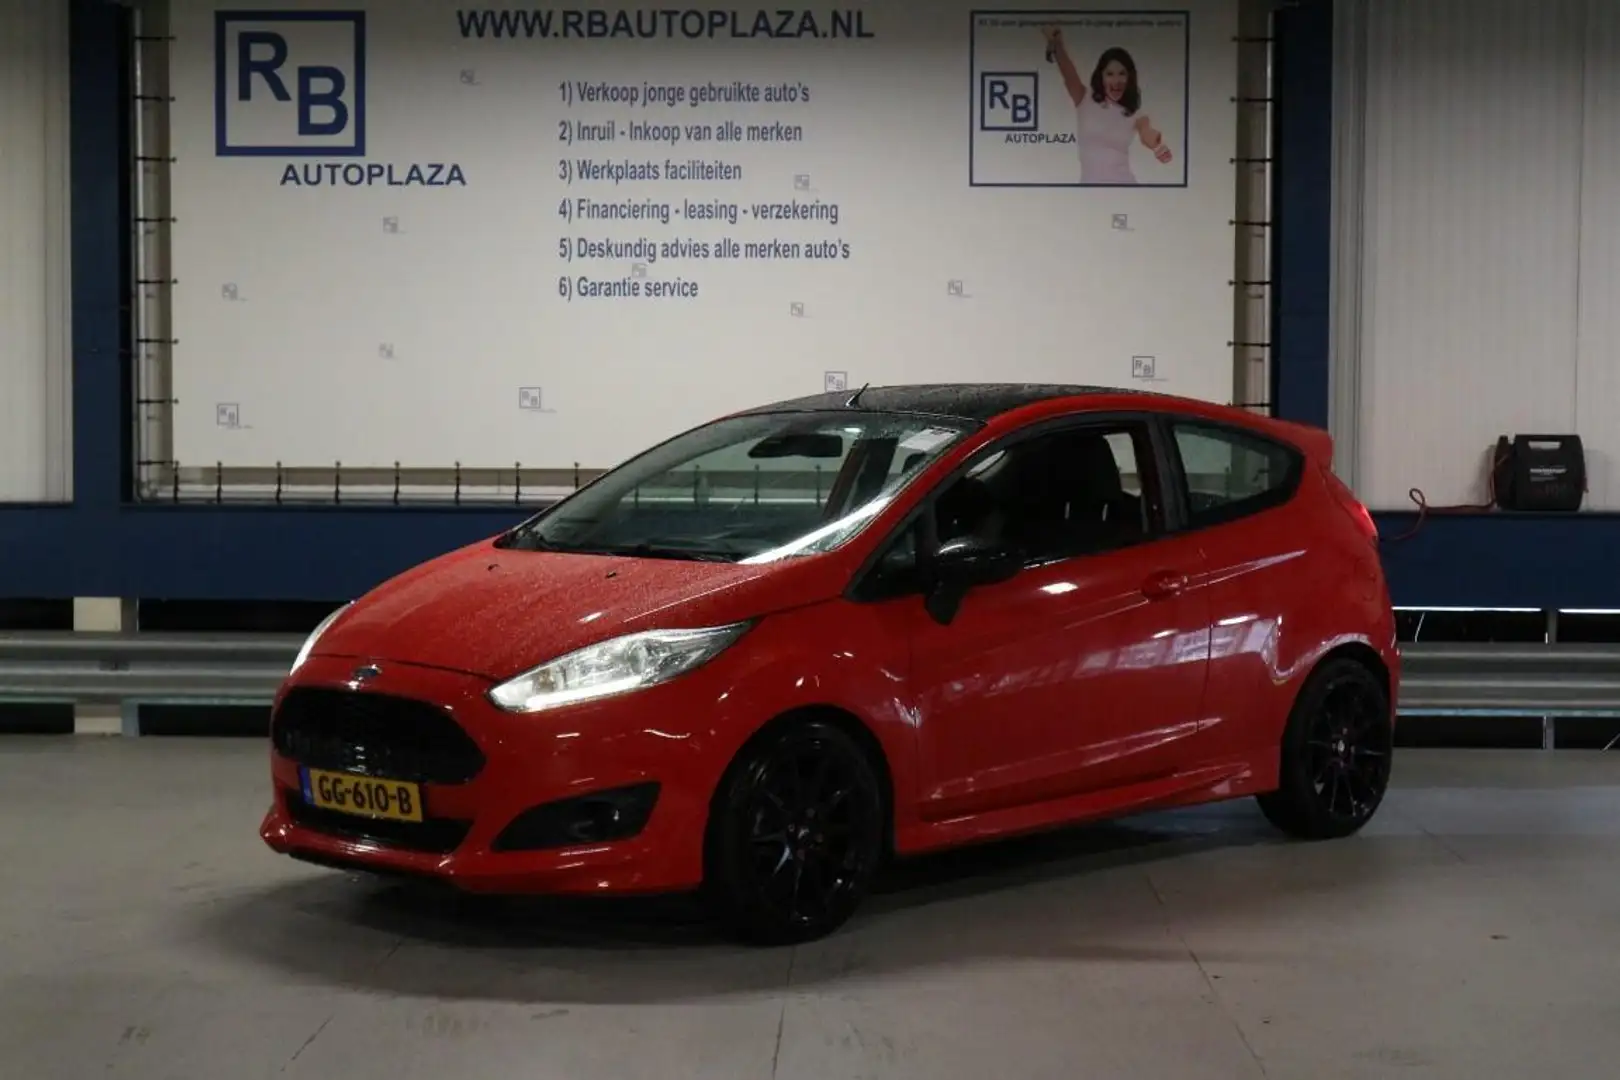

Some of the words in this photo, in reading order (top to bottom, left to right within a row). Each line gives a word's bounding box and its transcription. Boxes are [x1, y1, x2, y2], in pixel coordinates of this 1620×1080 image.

[457, 9, 875, 39] WWW.RBAUTOPLAZA.NL
[559, 81, 573, 107] 1)
[576, 81, 639, 107] Verkoop
[642, 81, 685, 108] jonge
[690, 81, 760, 108] gebruikte
[765, 82, 810, 103] auto's
[559, 120, 573, 146] 2)
[577, 120, 616, 142] Inruil
[630, 120, 680, 146] Inkoop
[685, 126, 712, 142] van
[716, 121, 743, 142] alle
[747, 121, 803, 142] merken
[1005, 133, 1076, 144] AUTOPLAZA
[280, 164, 467, 187] AUTOPLAZA
[559, 159, 573, 185] 3)
[577, 160, 660, 185] Werkplaats
[665, 160, 742, 181] faciliteiten
[559, 198, 573, 225] 4)
[577, 199, 670, 225] Financiering
[685, 199, 738, 225] leasing
[752, 200, 839, 226] verzekering
[559, 238, 573, 263] 5)
[577, 238, 657, 264] Deskundig
[662, 238, 710, 259] advies
[715, 238, 741, 259] alle
[745, 239, 800, 259] merken
[805, 239, 851, 260] auto's
[559, 277, 573, 302] 6)
[577, 276, 640, 298] Garantie
[645, 277, 699, 298] service
[318, 775, 413, 816] GG-610-B
